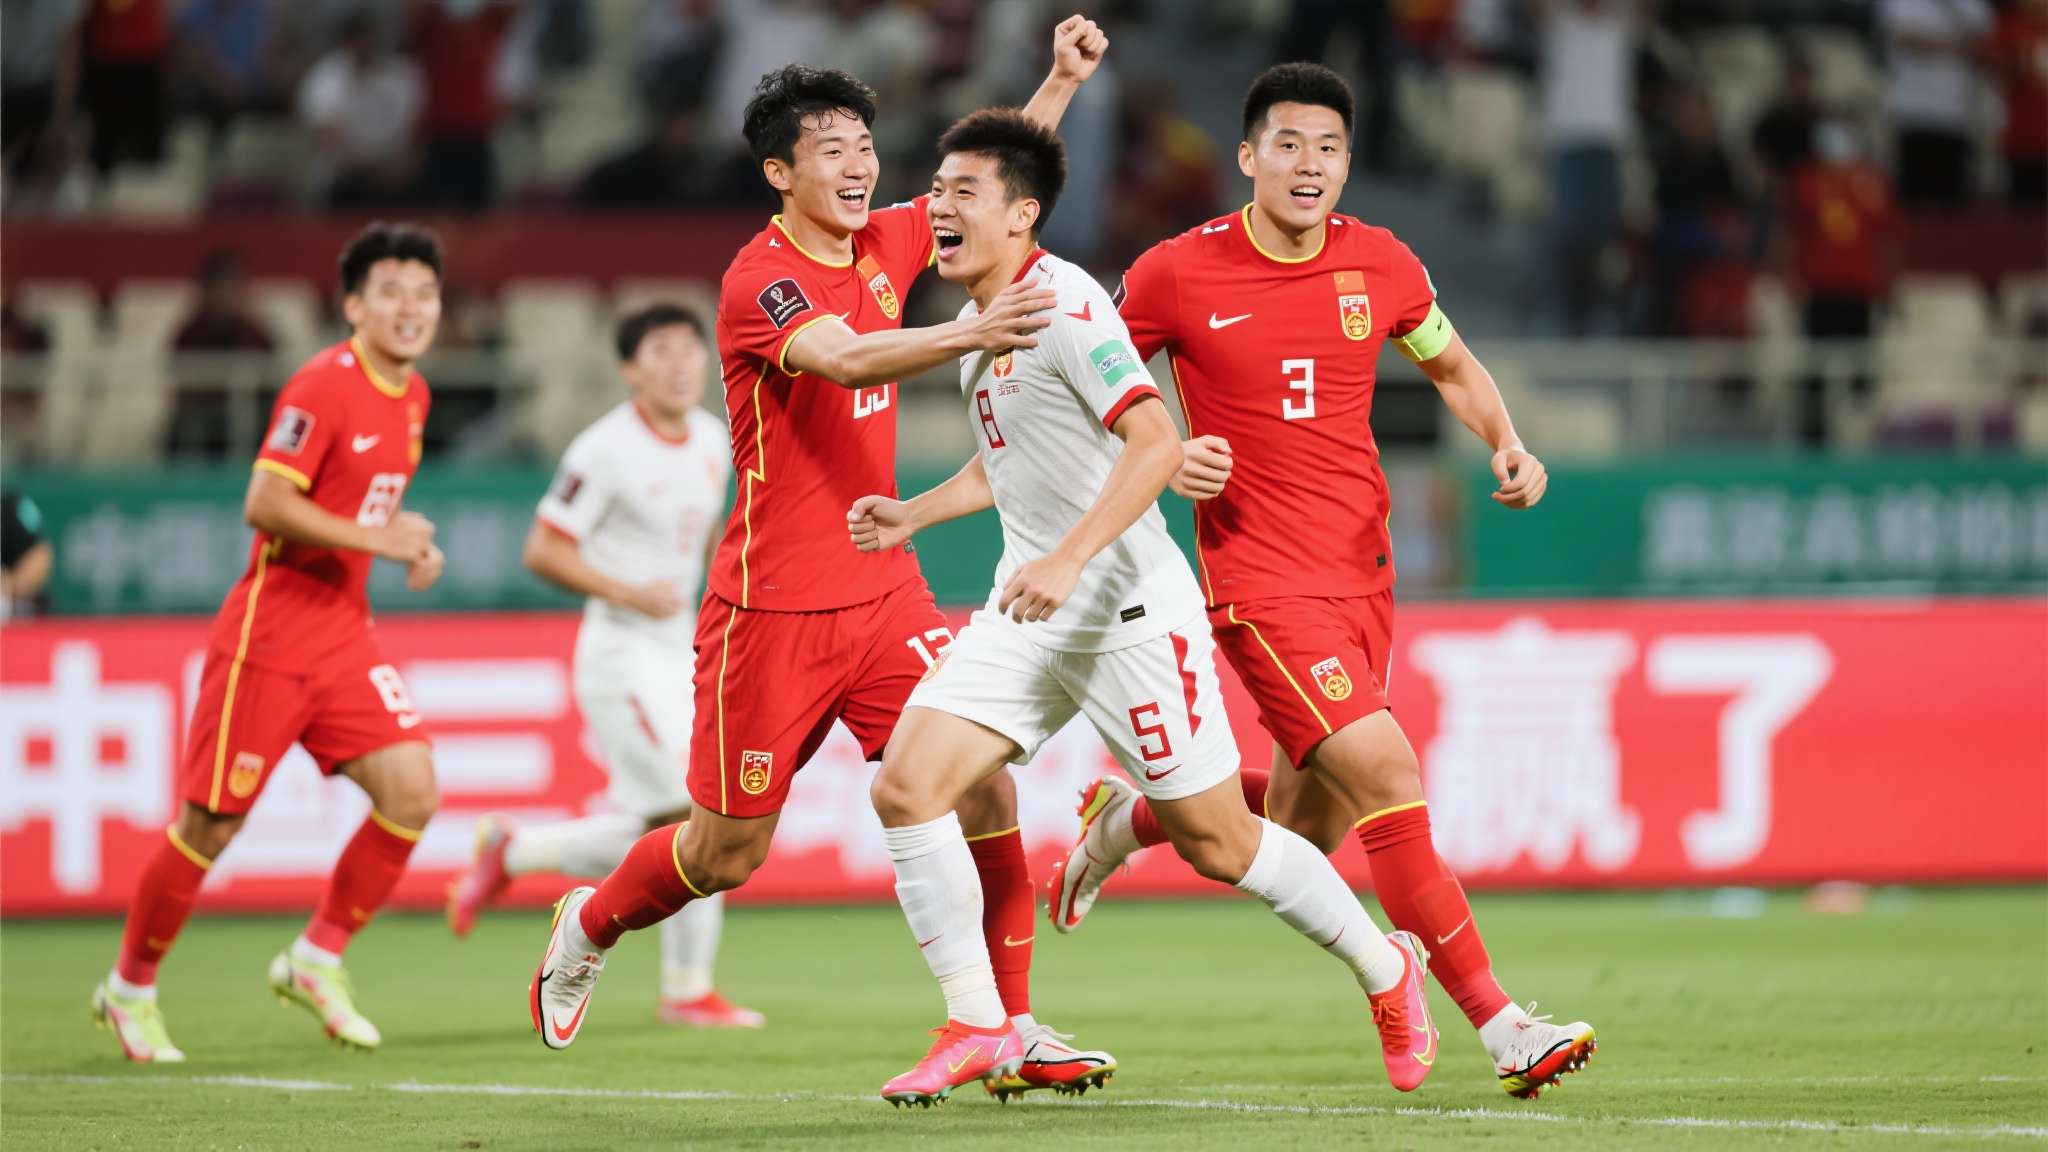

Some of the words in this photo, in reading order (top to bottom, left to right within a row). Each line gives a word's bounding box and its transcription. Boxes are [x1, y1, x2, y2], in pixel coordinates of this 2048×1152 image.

[976, 389, 1005, 449] 8
[1282, 358, 1316, 420] 3
[1128, 701, 1173, 762] 5
[1408, 617, 1836, 873] 赢了
